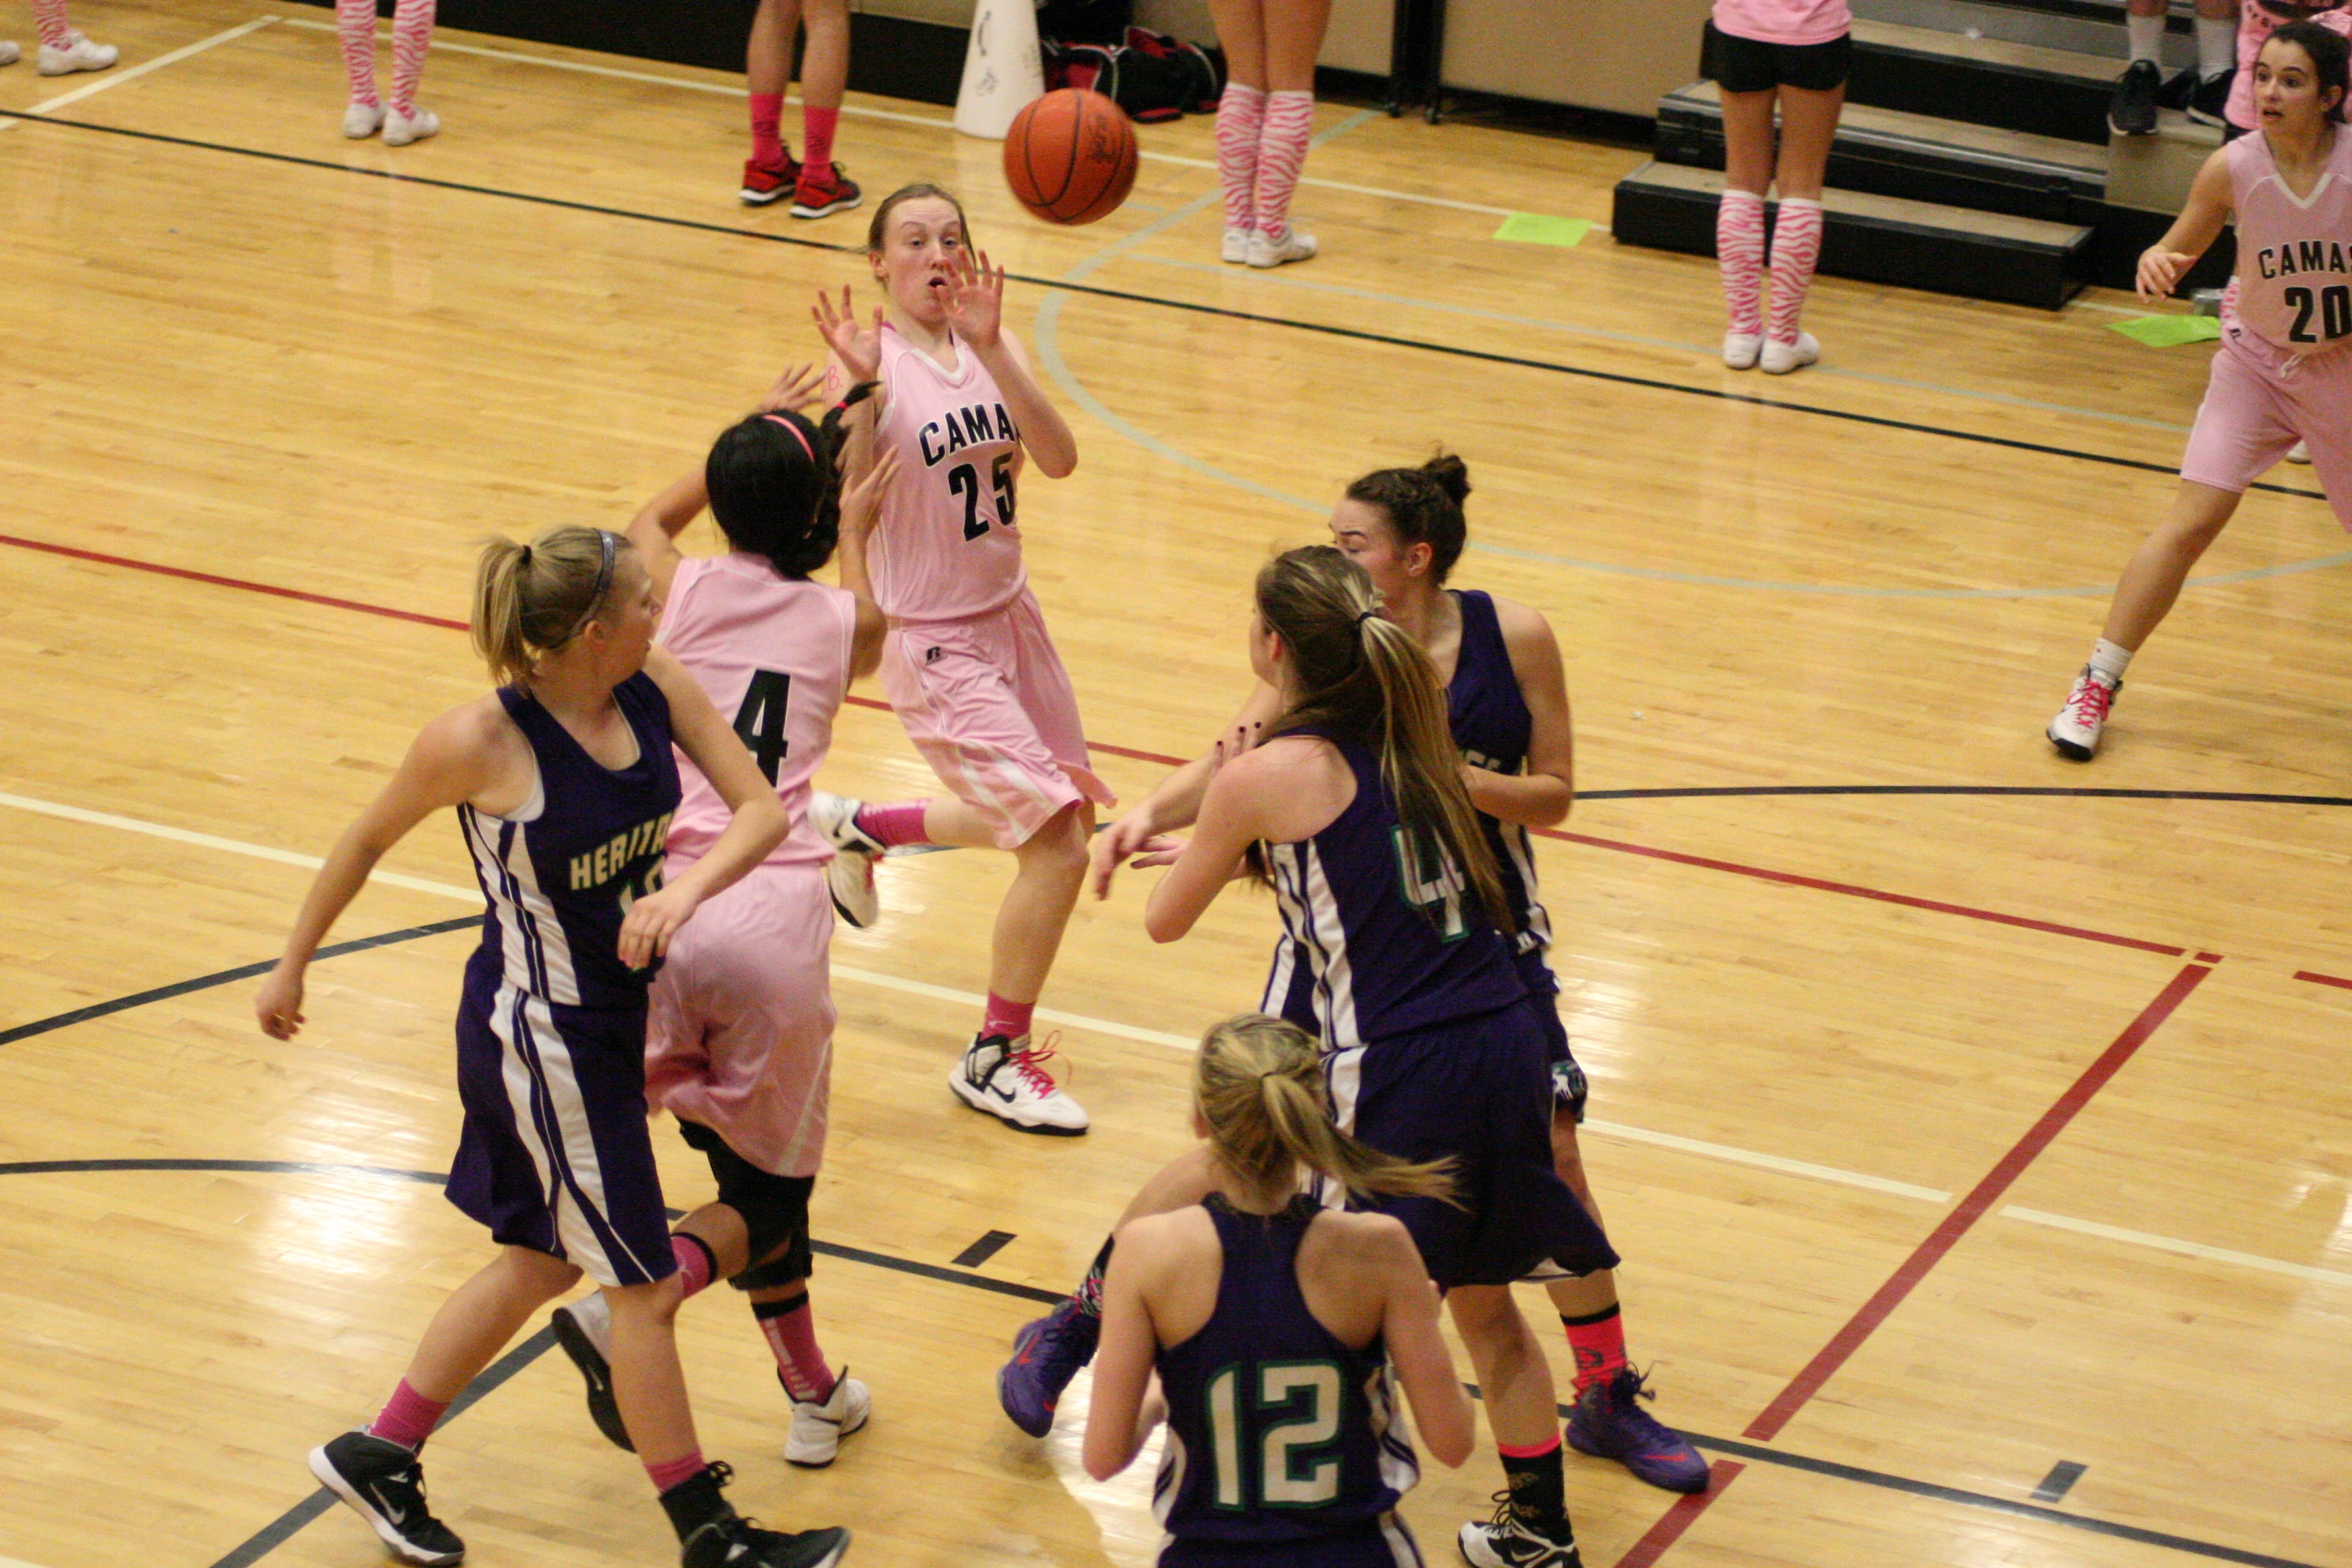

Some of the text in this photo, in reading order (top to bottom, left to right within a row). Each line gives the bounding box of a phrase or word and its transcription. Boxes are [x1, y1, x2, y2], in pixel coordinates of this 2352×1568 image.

[2258, 240, 2351, 280] CAMA
[2284, 285, 2351, 343] 20
[918, 403, 1020, 467] CAMA
[948, 450, 1016, 542] 25
[732, 668, 791, 789] 4
[1391, 824, 1471, 943] 4
[1204, 1358, 1344, 1511] 12
